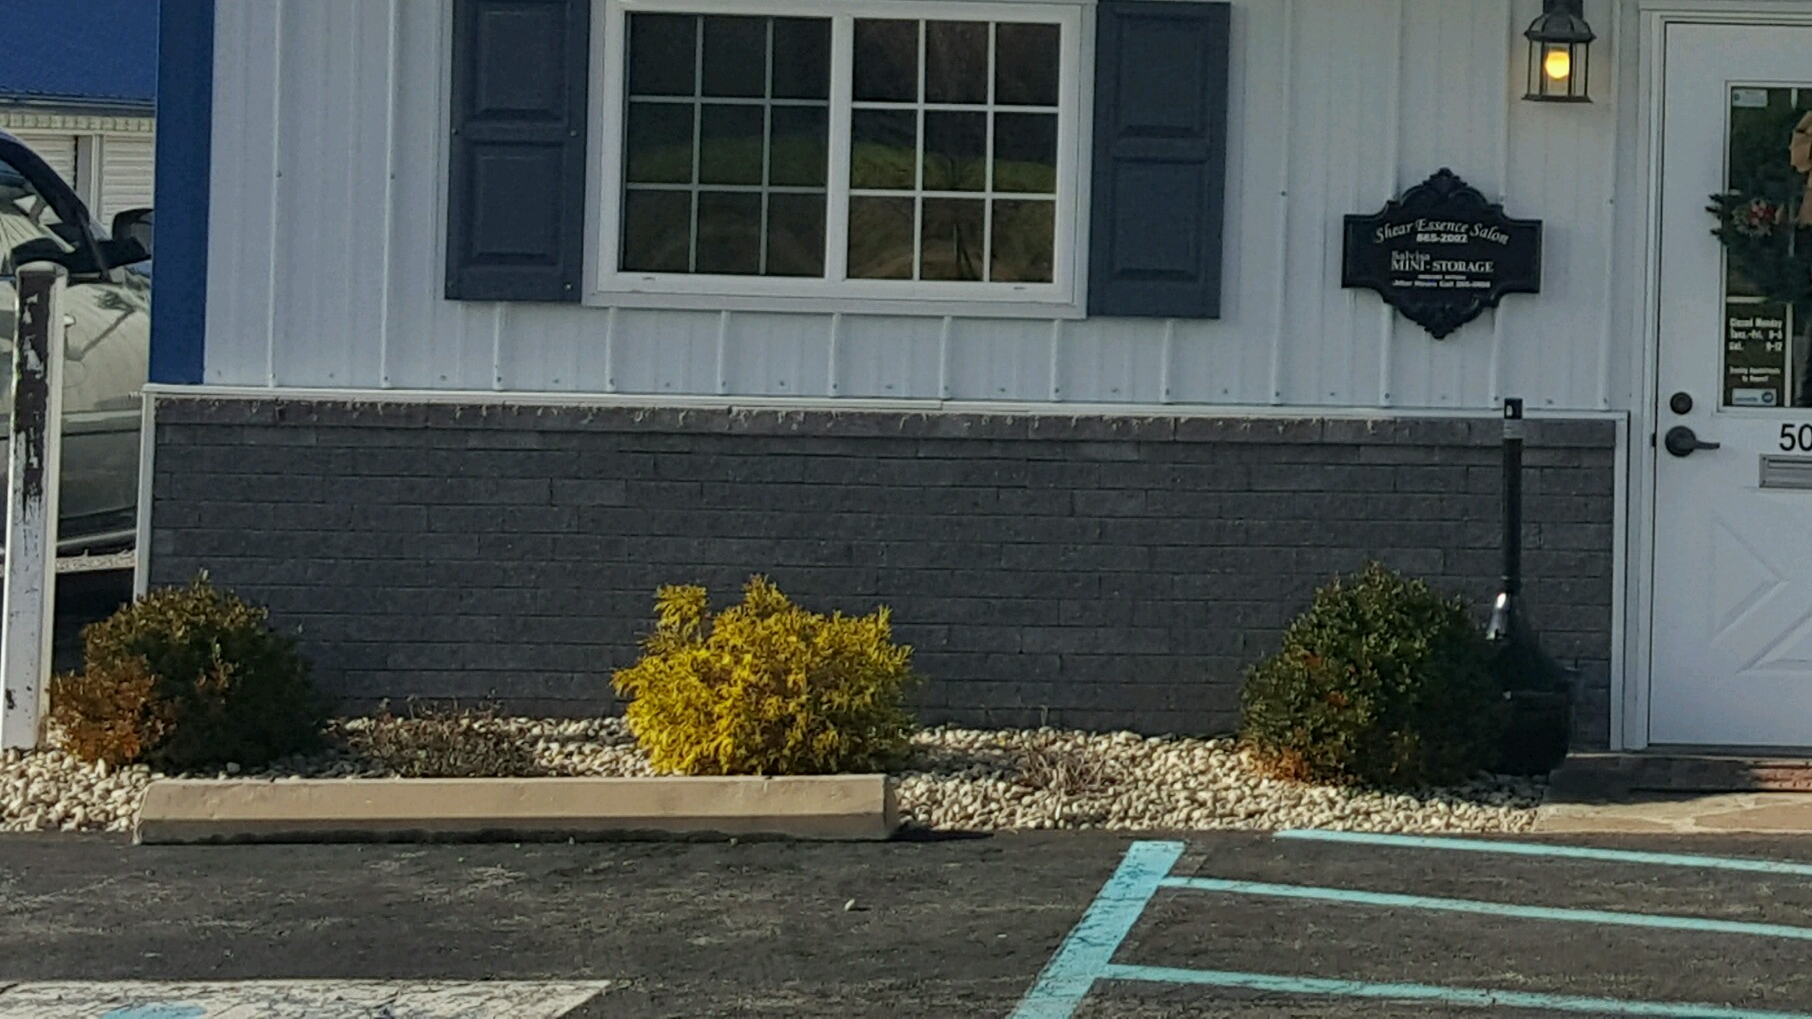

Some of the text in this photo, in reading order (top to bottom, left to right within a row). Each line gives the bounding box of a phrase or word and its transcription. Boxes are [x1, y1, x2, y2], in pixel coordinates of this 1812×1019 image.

[1374, 218, 1509, 245] Shear Essence Salon
